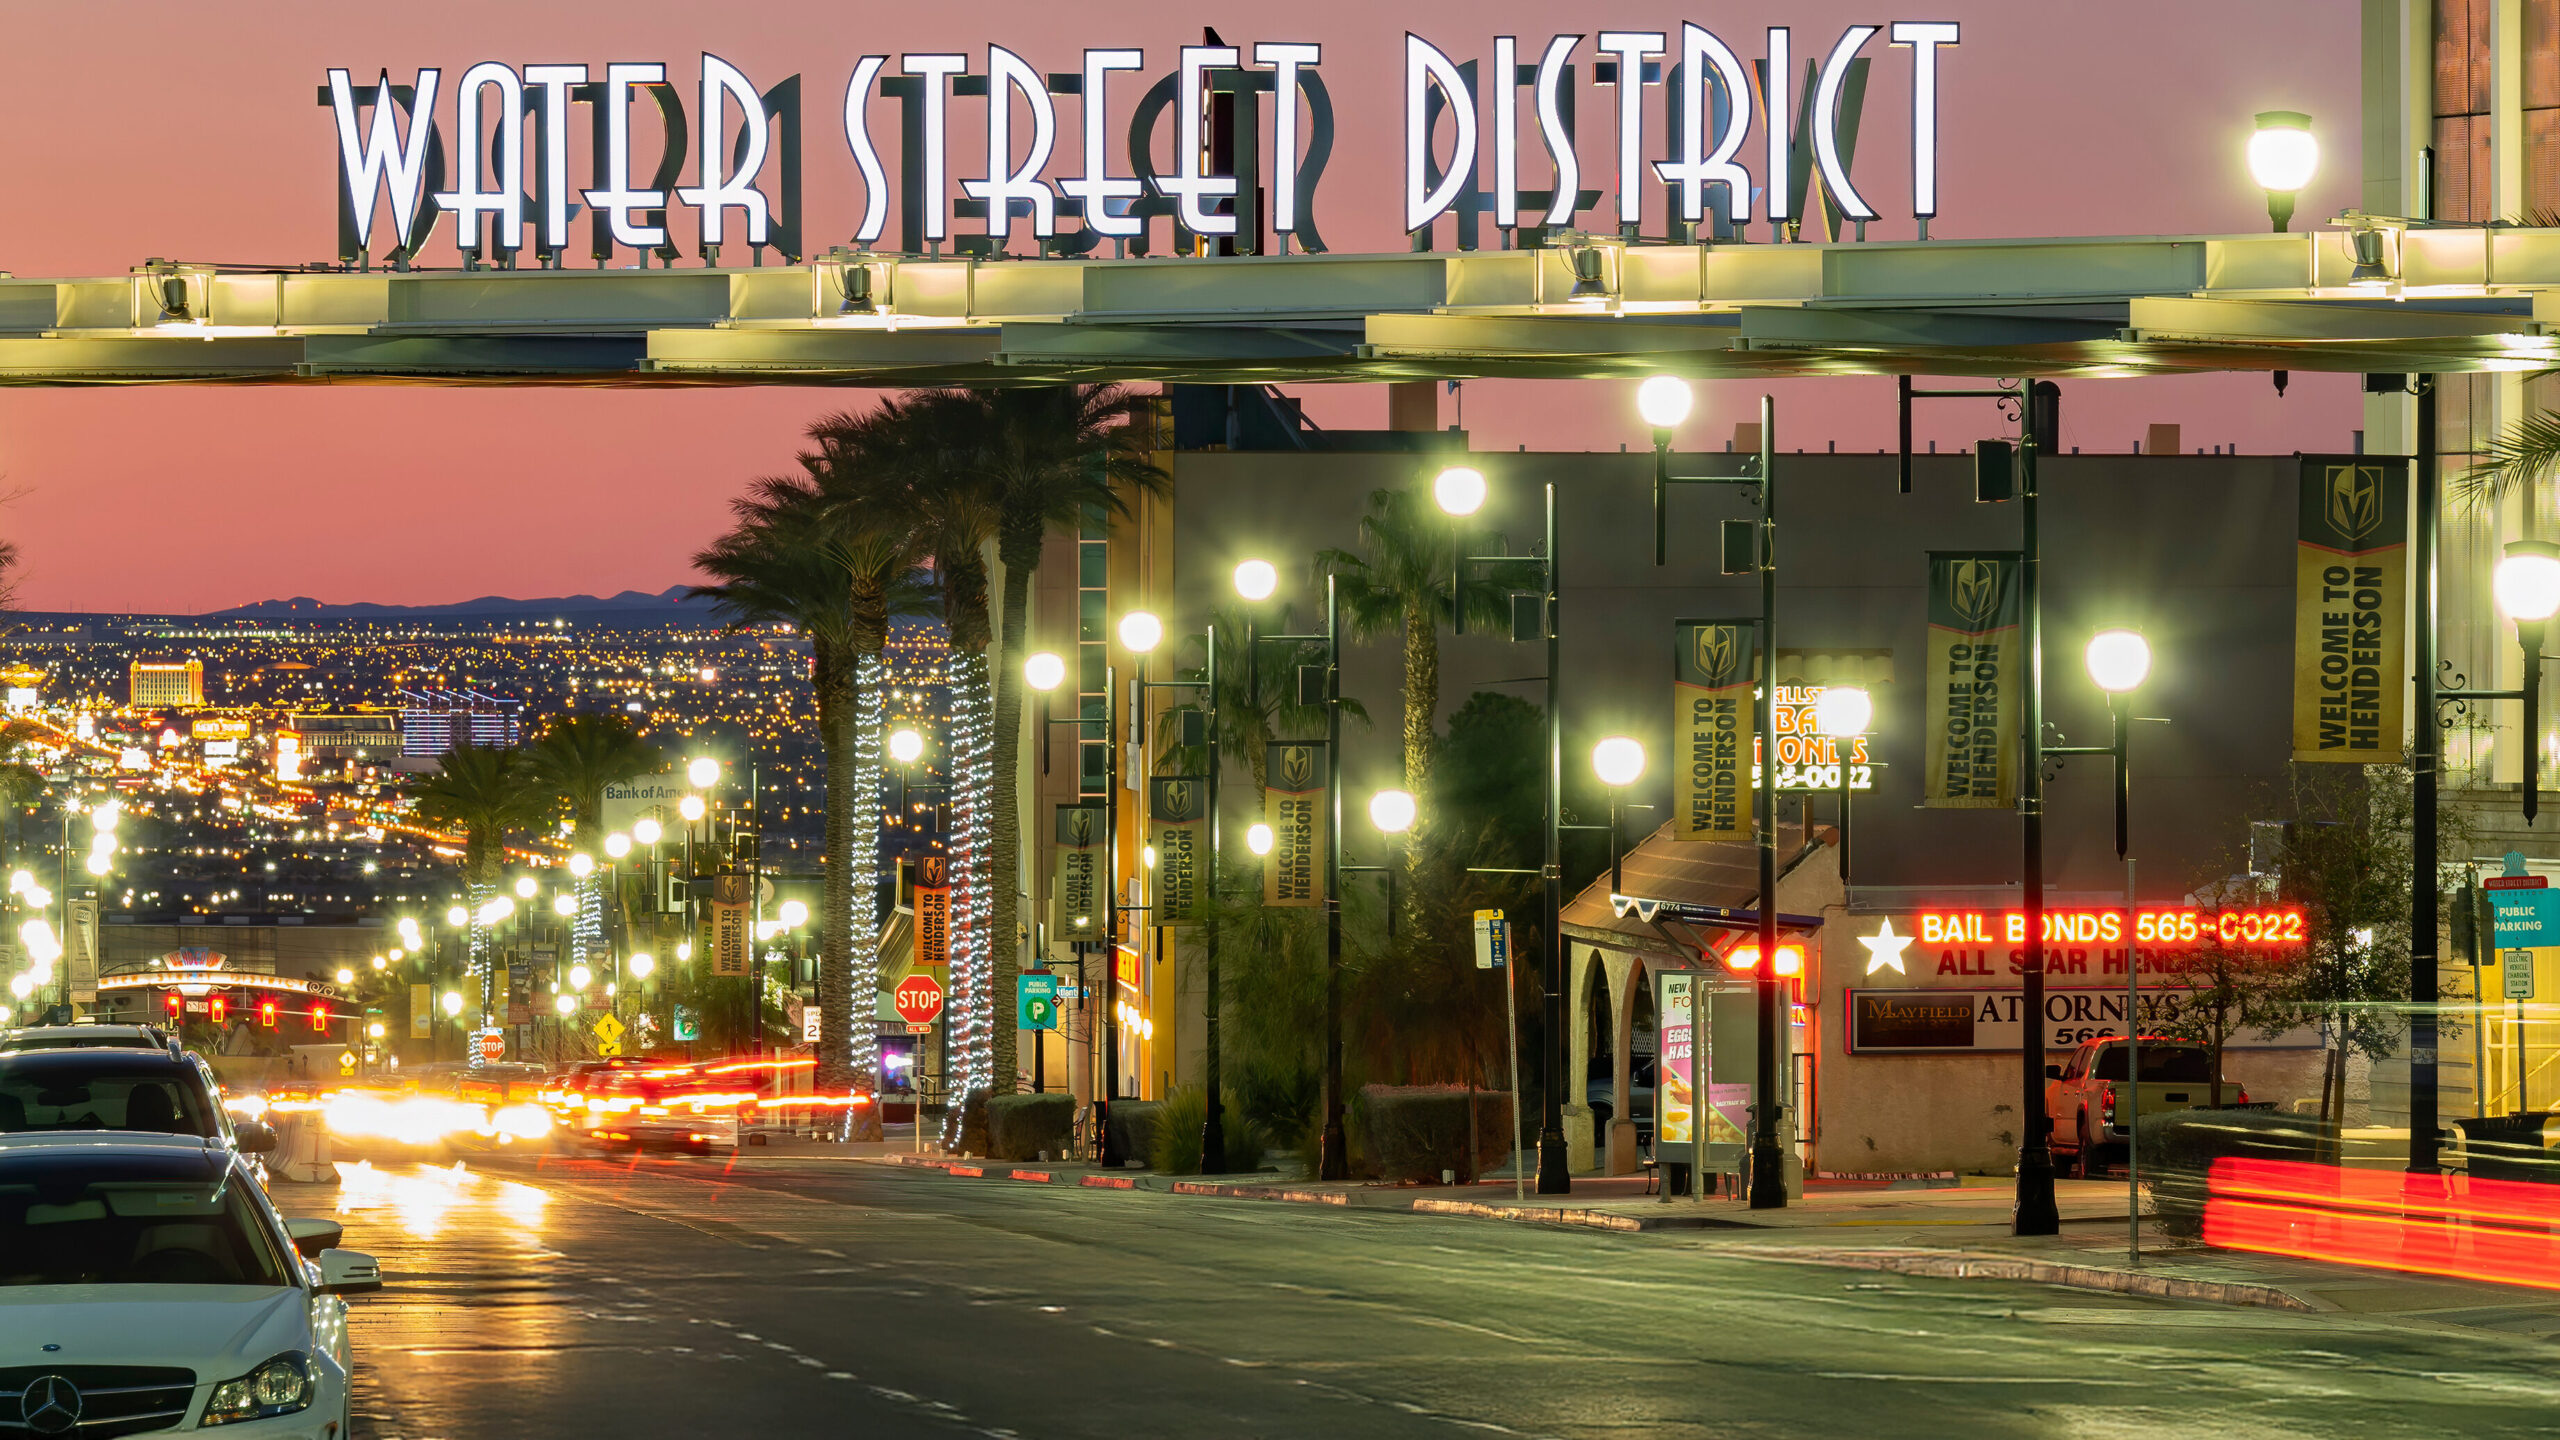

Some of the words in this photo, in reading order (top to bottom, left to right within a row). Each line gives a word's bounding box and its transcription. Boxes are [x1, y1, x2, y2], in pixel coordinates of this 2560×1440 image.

[327, 51, 769, 252] WATER
[843, 41, 1322, 244] STREET
[1404, 19, 1961, 235] DISTRICT
[2323, 565, 2351, 602] TO
[1949, 643, 1972, 676] TO
[2350, 566, 2383, 750] HENDERSON
[2319, 612, 2350, 751] WELCOME
[1693, 698, 1714, 724] TO
[1972, 644, 1999, 797] HENDERSON
[1947, 682, 1972, 798] WELCOME
[1693, 732, 1714, 832] WELCOME
[1713, 698, 1737, 831] HENDERSON
[606, 786, 639, 799] Bank
[641, 785, 655, 799] of
[1279, 799, 1295, 823] TO
[1164, 829, 1177, 850] TO
[1293, 800, 1312, 900] HENDERSON
[1067, 852, 1080, 873] TO
[1178, 829, 1193, 921] HENDERSON
[1278, 829, 1294, 900] WELCOME
[923, 893, 934, 910] TO
[1163, 852, 1178, 921] WELCOME
[721, 909, 731, 923] TO
[1065, 874, 1080, 936] WELCOME
[1660, 902, 1681, 911] 6774
[2499, 906, 2536, 917] PUBLIC
[731, 909, 742, 971] HENDERSON
[923, 914, 934, 961] WELCOME
[934, 894, 945, 962] HENDERSON
[1921, 913, 1994, 943] BAIL
[2136, 911, 2303, 943] 565-0022
[2494, 921, 2543, 932] PARKING
[721, 925, 731, 971] WELCOME
[1936, 949, 1996, 976] ALL
[2009, 949, 2087, 976] SAR
[898, 990, 940, 1009] STOP
[1668, 983, 1687, 994] NEW
[1867, 999, 1971, 1021] MAYFIELD
[1977, 994, 2180, 1023] ATORNYS
[481, 1042, 504, 1052] STOP
